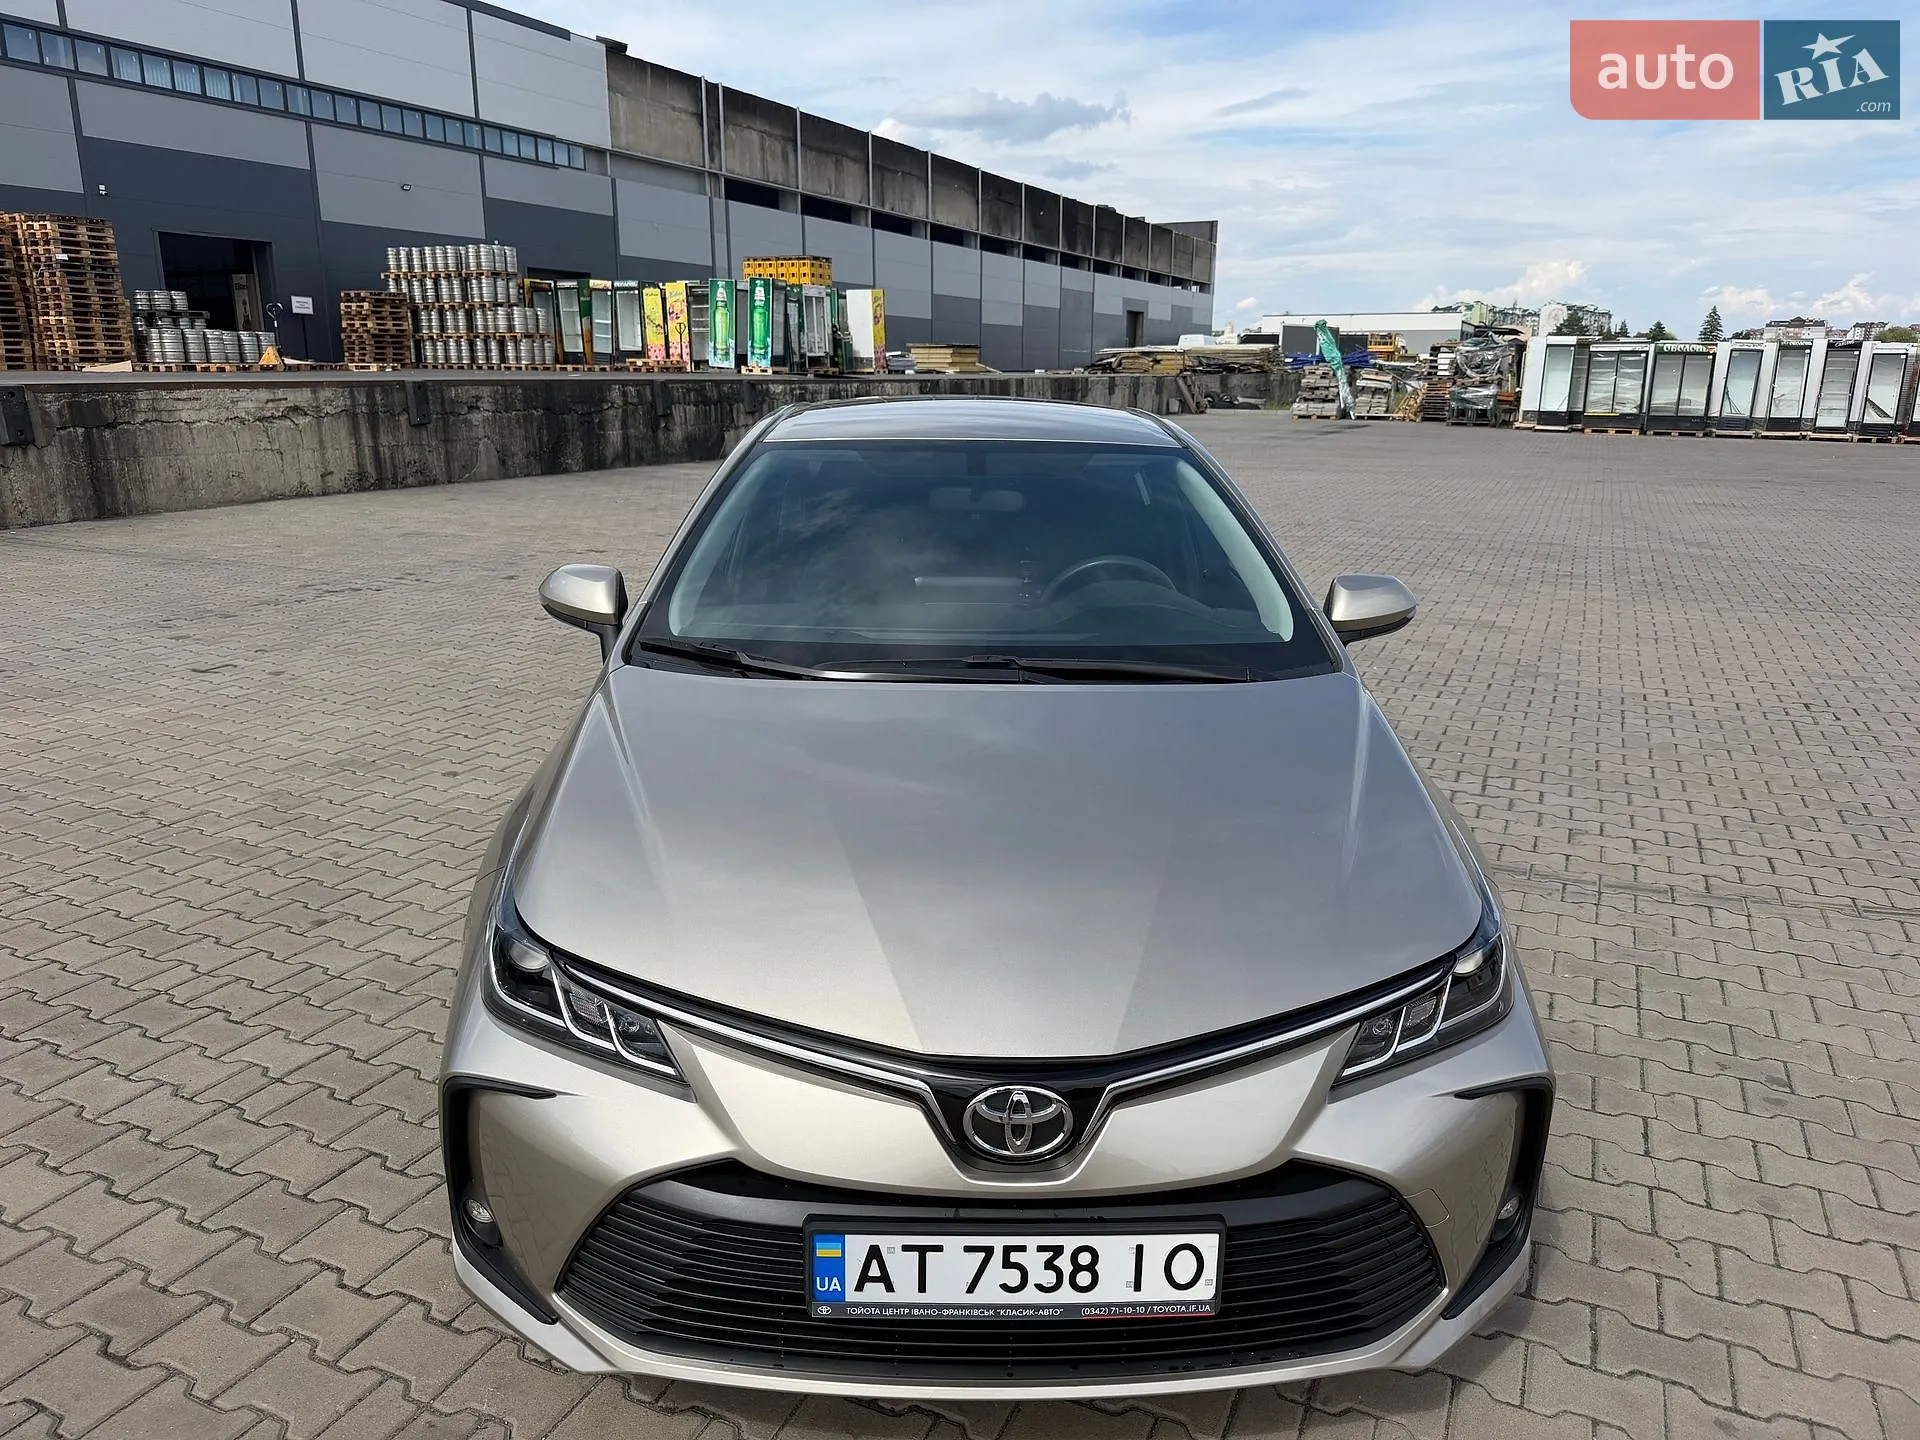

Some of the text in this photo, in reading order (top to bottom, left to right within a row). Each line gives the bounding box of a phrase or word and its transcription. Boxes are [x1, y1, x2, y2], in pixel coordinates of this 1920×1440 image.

[854, 1243, 1205, 1294] AT 7538 IO
[816, 1277, 842, 1291] UA
[846, 1306, 881, 1315] ТОЙОТА
[882, 1308, 910, 1316] ЦЕНТР
[911, 1308, 995, 1316] ІВАНО-ФРАНКІВСЬК
[1081, 1307, 1109, 1316] (0342)
[1110, 1306, 1145, 1314] 71-10-10
[1153, 1304, 1211, 1313] TOYOTA.IF.UA
